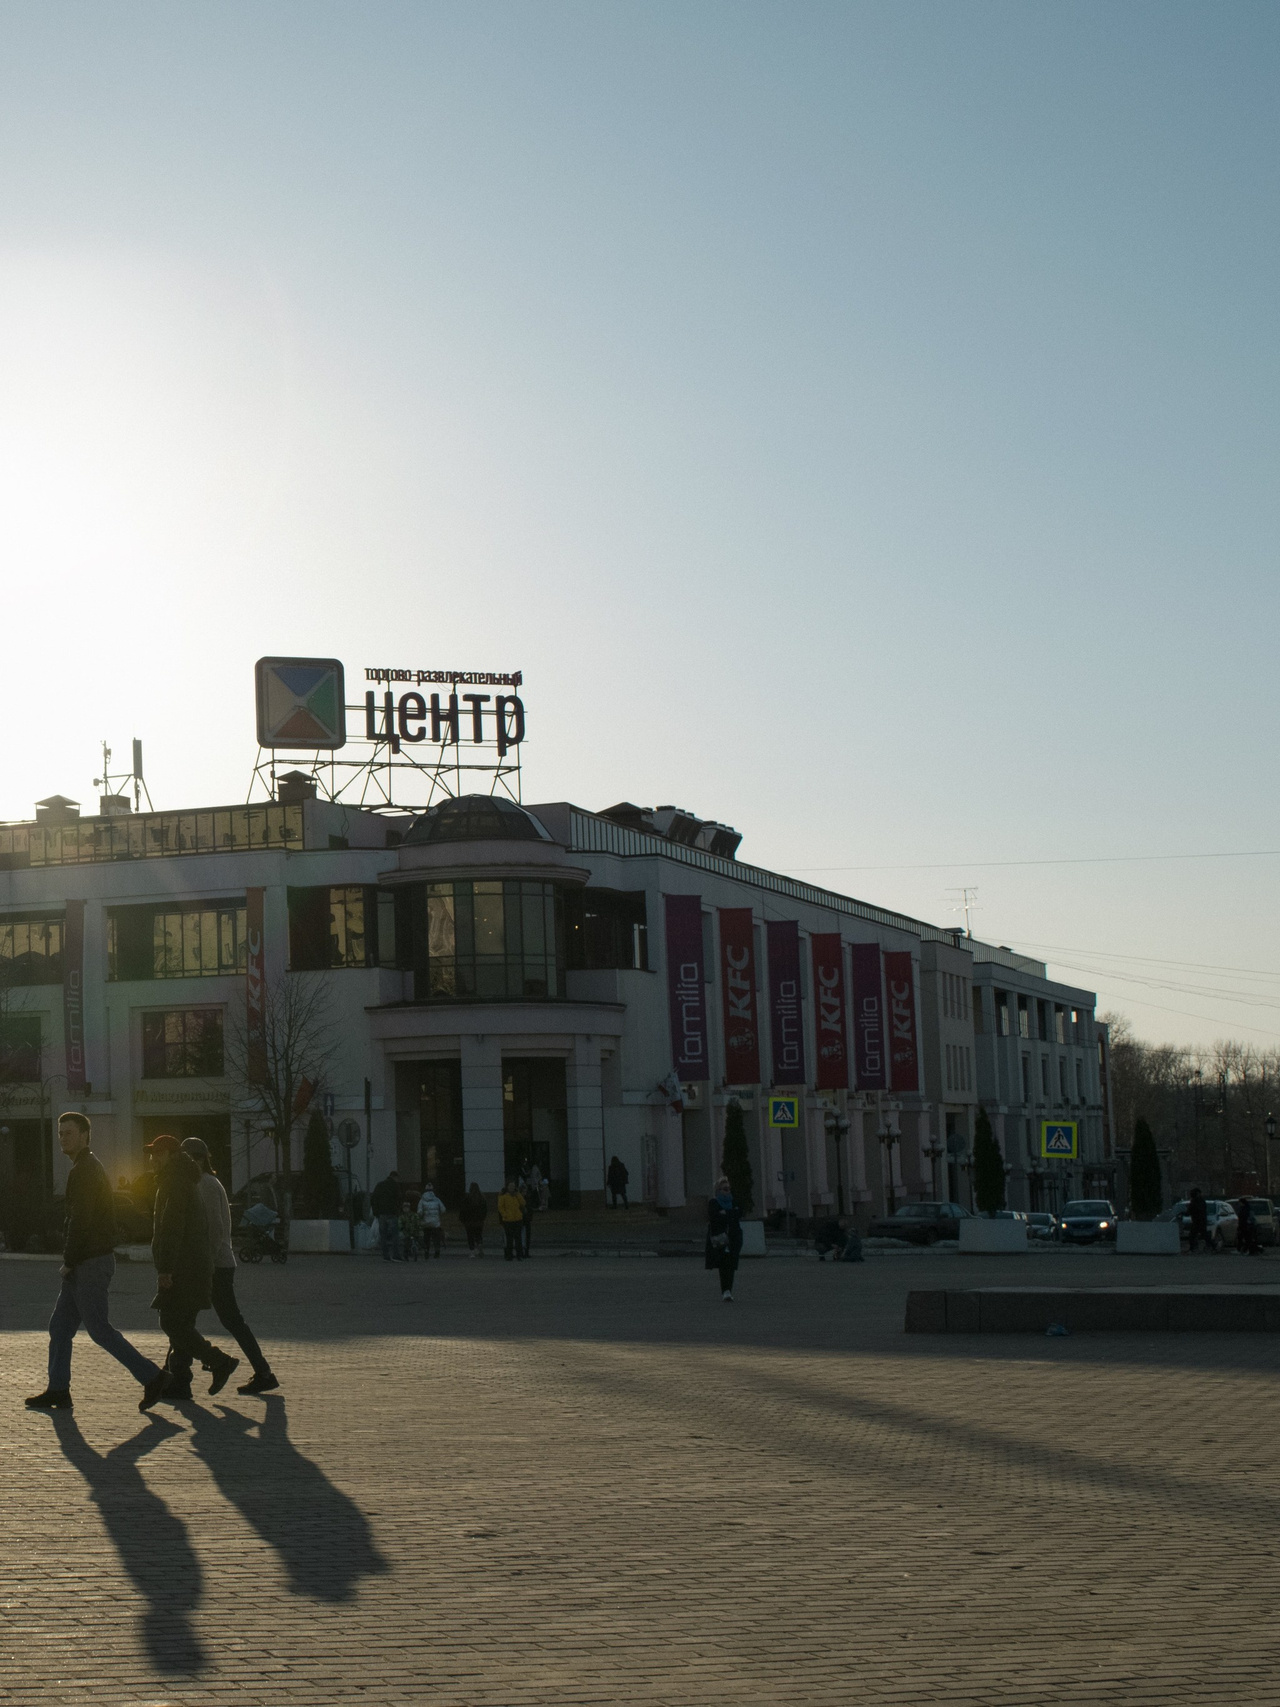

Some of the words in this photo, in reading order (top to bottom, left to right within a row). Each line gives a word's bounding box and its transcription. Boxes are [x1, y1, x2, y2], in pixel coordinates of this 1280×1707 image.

[364, 667, 523, 687] торгово-развлекательный
[365, 690, 526, 757] центр
[248, 929, 263, 1015] KFC
[726, 944, 752, 1022] KFC
[818, 965, 842, 1035] KFC
[890, 980, 913, 1042] KFC
[67, 968, 84, 1074] familia
[675, 962, 703, 1064] familia
[775, 980, 800, 1070] familia
[858, 996, 881, 1077] familia
